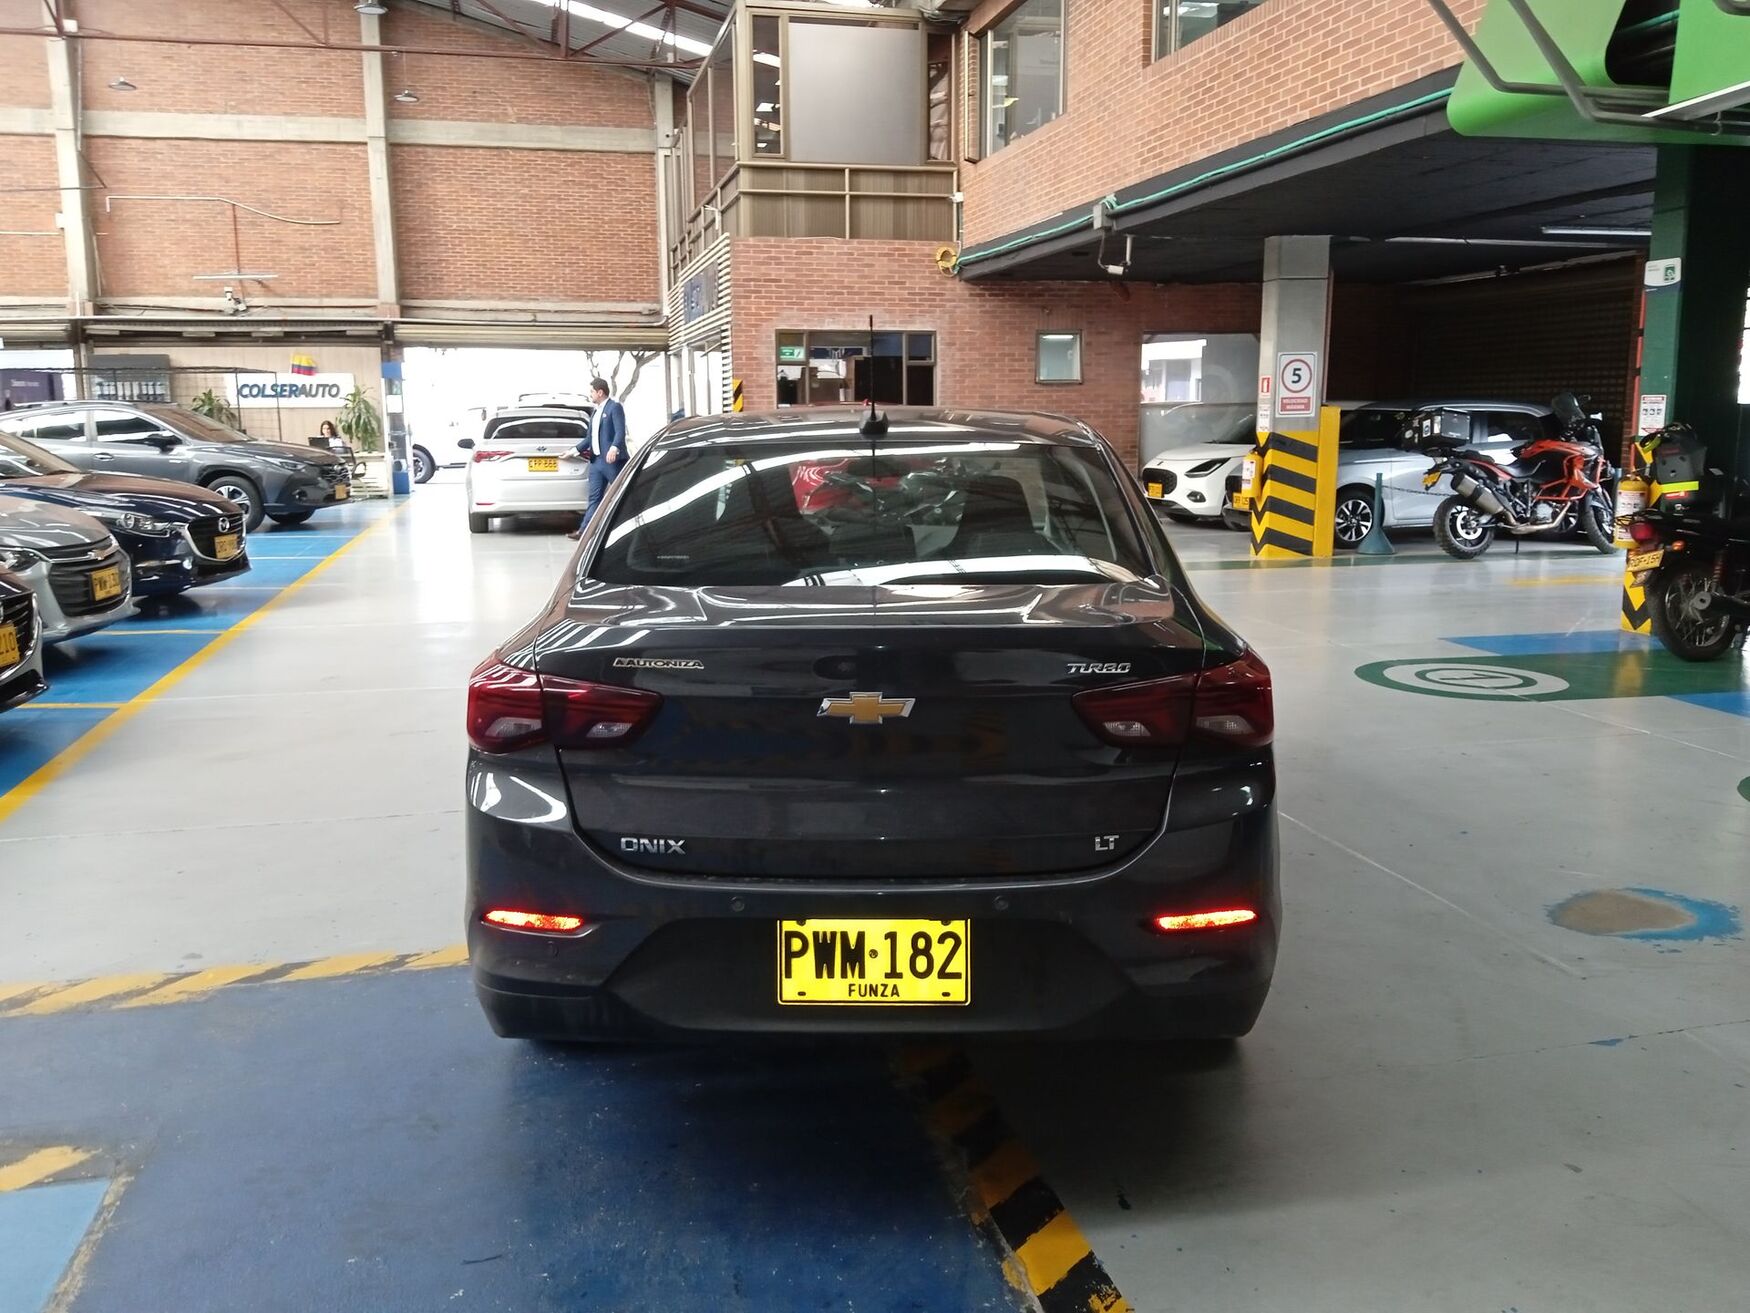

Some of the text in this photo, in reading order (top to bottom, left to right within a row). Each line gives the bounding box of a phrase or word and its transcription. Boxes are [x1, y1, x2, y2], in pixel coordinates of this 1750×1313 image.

[1291, 367, 1302, 384] 5
[238, 383, 340, 399] COLSERAUTO
[1067, 662, 1131, 674] TURBO
[620, 837, 686, 855] ONIX
[1094, 834, 1120, 851] LT
[848, 983, 901, 998] FUNZA
